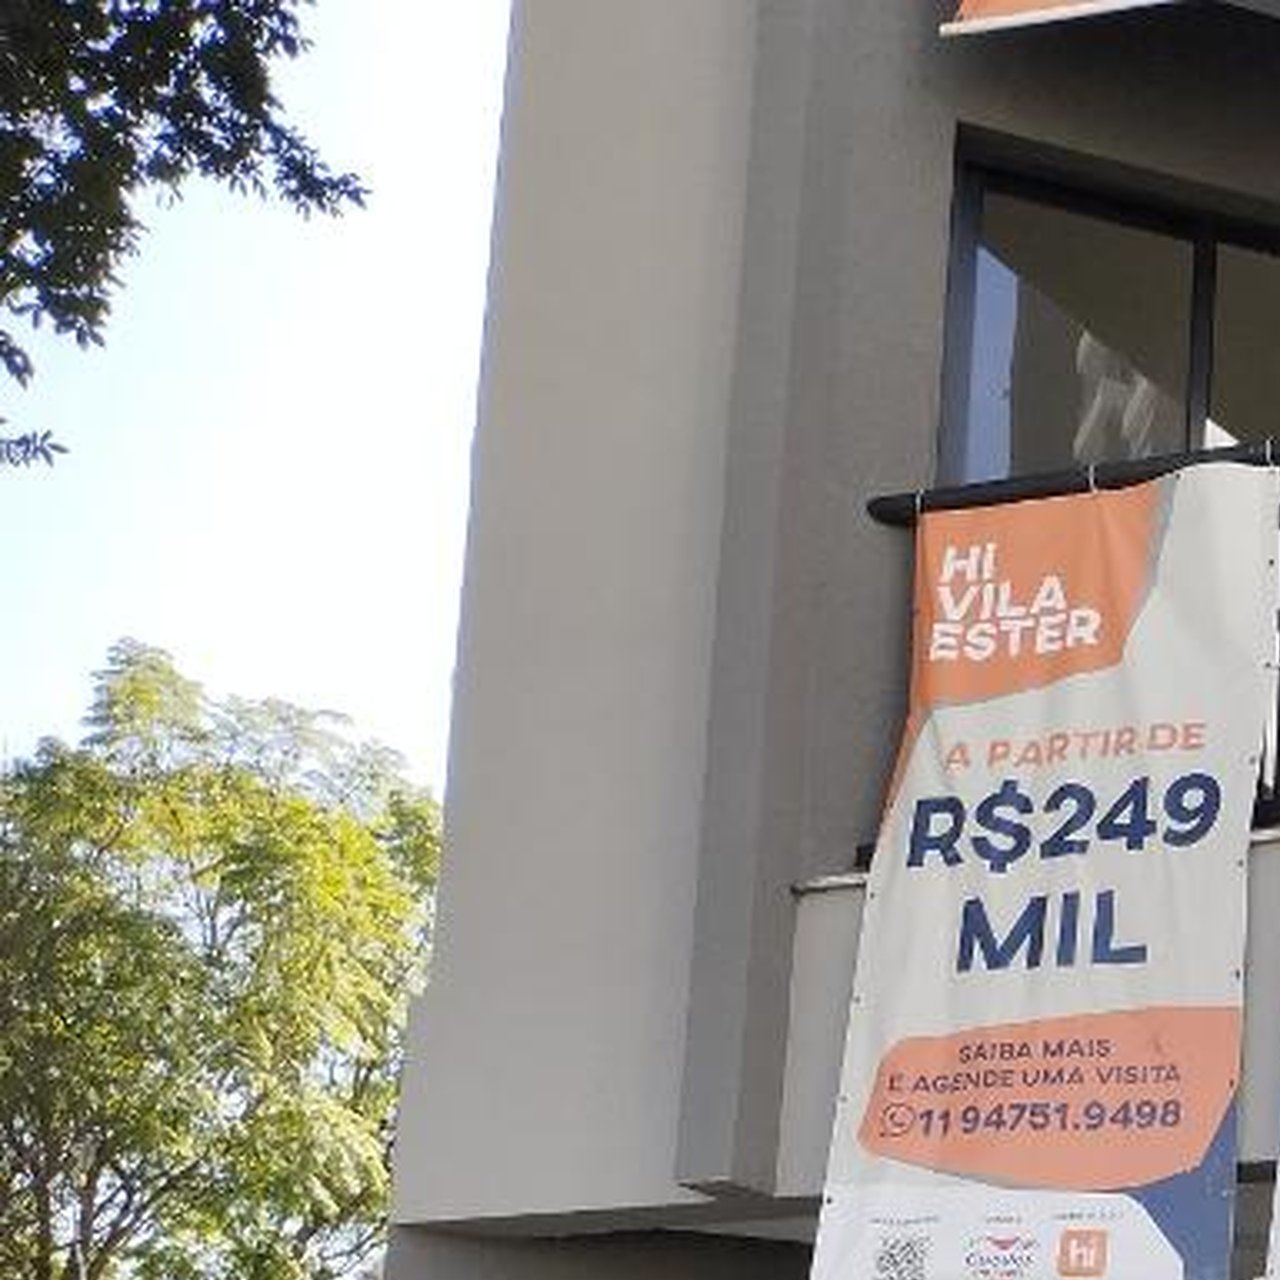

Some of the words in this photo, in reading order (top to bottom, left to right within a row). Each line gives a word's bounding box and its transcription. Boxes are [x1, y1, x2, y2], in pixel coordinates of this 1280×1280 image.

[937, 576, 1068, 621] VILA
[930, 609, 1102, 661] ESTER
[944, 746, 970, 771] A
[988, 731, 1142, 769] PARTIR
[1148, 722, 1206, 752] DE
[906, 773, 1222, 873] R$249
[956, 889, 1147, 973] MIL
[959, 1041, 1033, 1065] SAIBA
[1043, 1039, 1112, 1060] MAIS
[912, 1069, 1014, 1094] AGENDE
[1021, 1065, 1085, 1088] UMA
[1096, 1064, 1182, 1086] VISITA
[918, 1109, 950, 1138] 11
[961, 1100, 1182, 1136] 94751.9498
